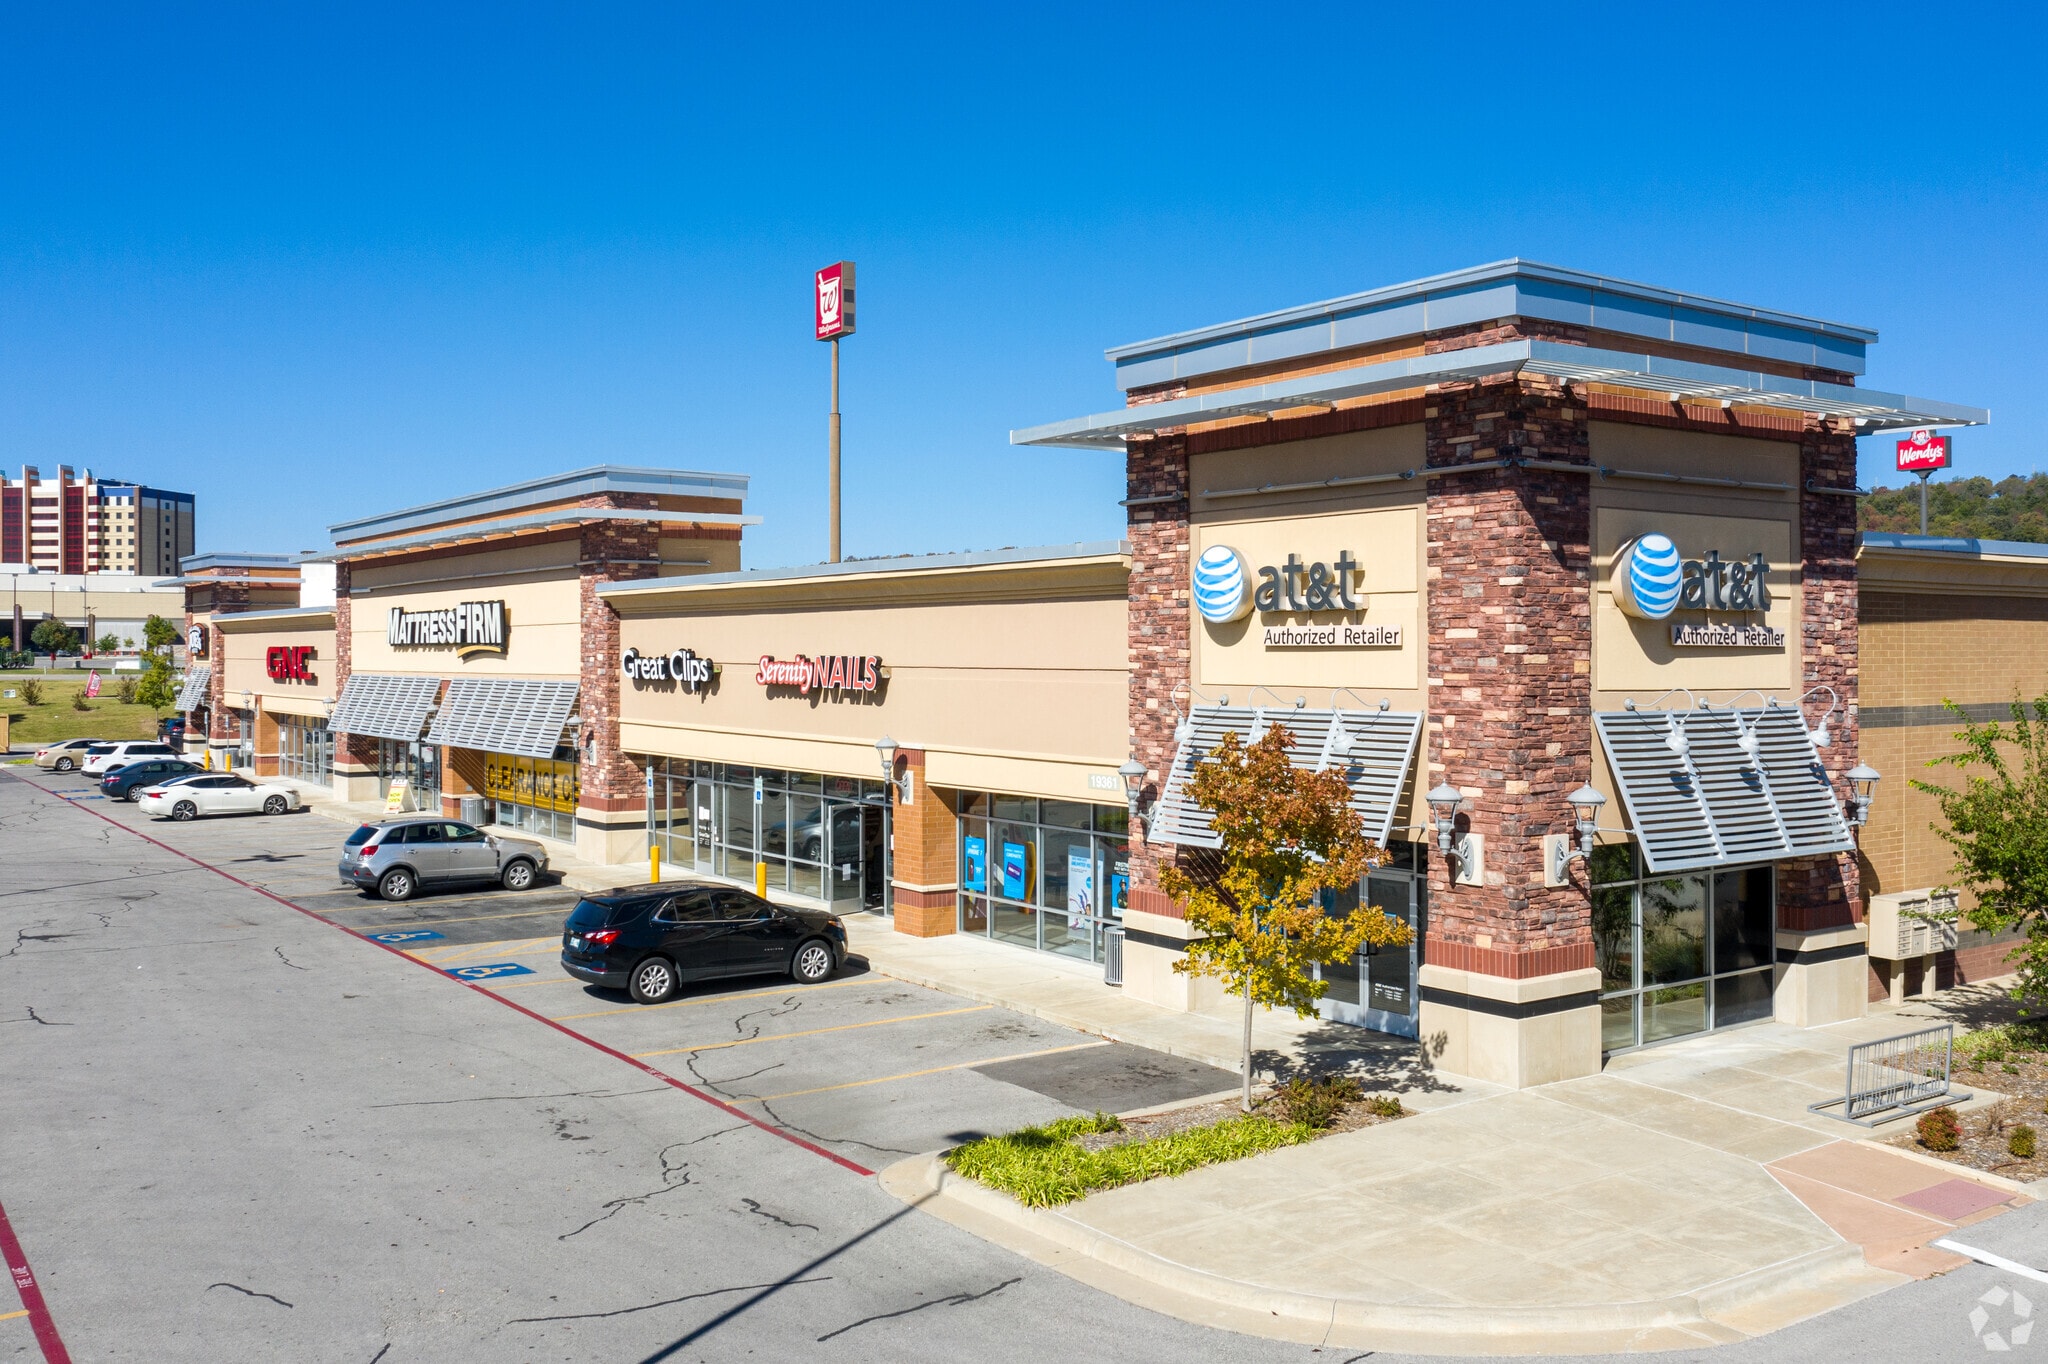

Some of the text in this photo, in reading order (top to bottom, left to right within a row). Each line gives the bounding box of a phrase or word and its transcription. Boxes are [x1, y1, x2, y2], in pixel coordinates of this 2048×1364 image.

[1899, 442, 1944, 466] Wendy's
[1254, 549, 1358, 612] at&t
[1682, 549, 1771, 612] at&t
[1263, 626, 1400, 645] Authorized Retailer
[1674, 626, 1785, 647] Authorized Retailer
[266, 646, 313, 680] GNC
[622, 648, 711, 690] Great Clips
[756, 654, 879, 694] Serenity NAILS
[1091, 775, 1118, 789] 19361
